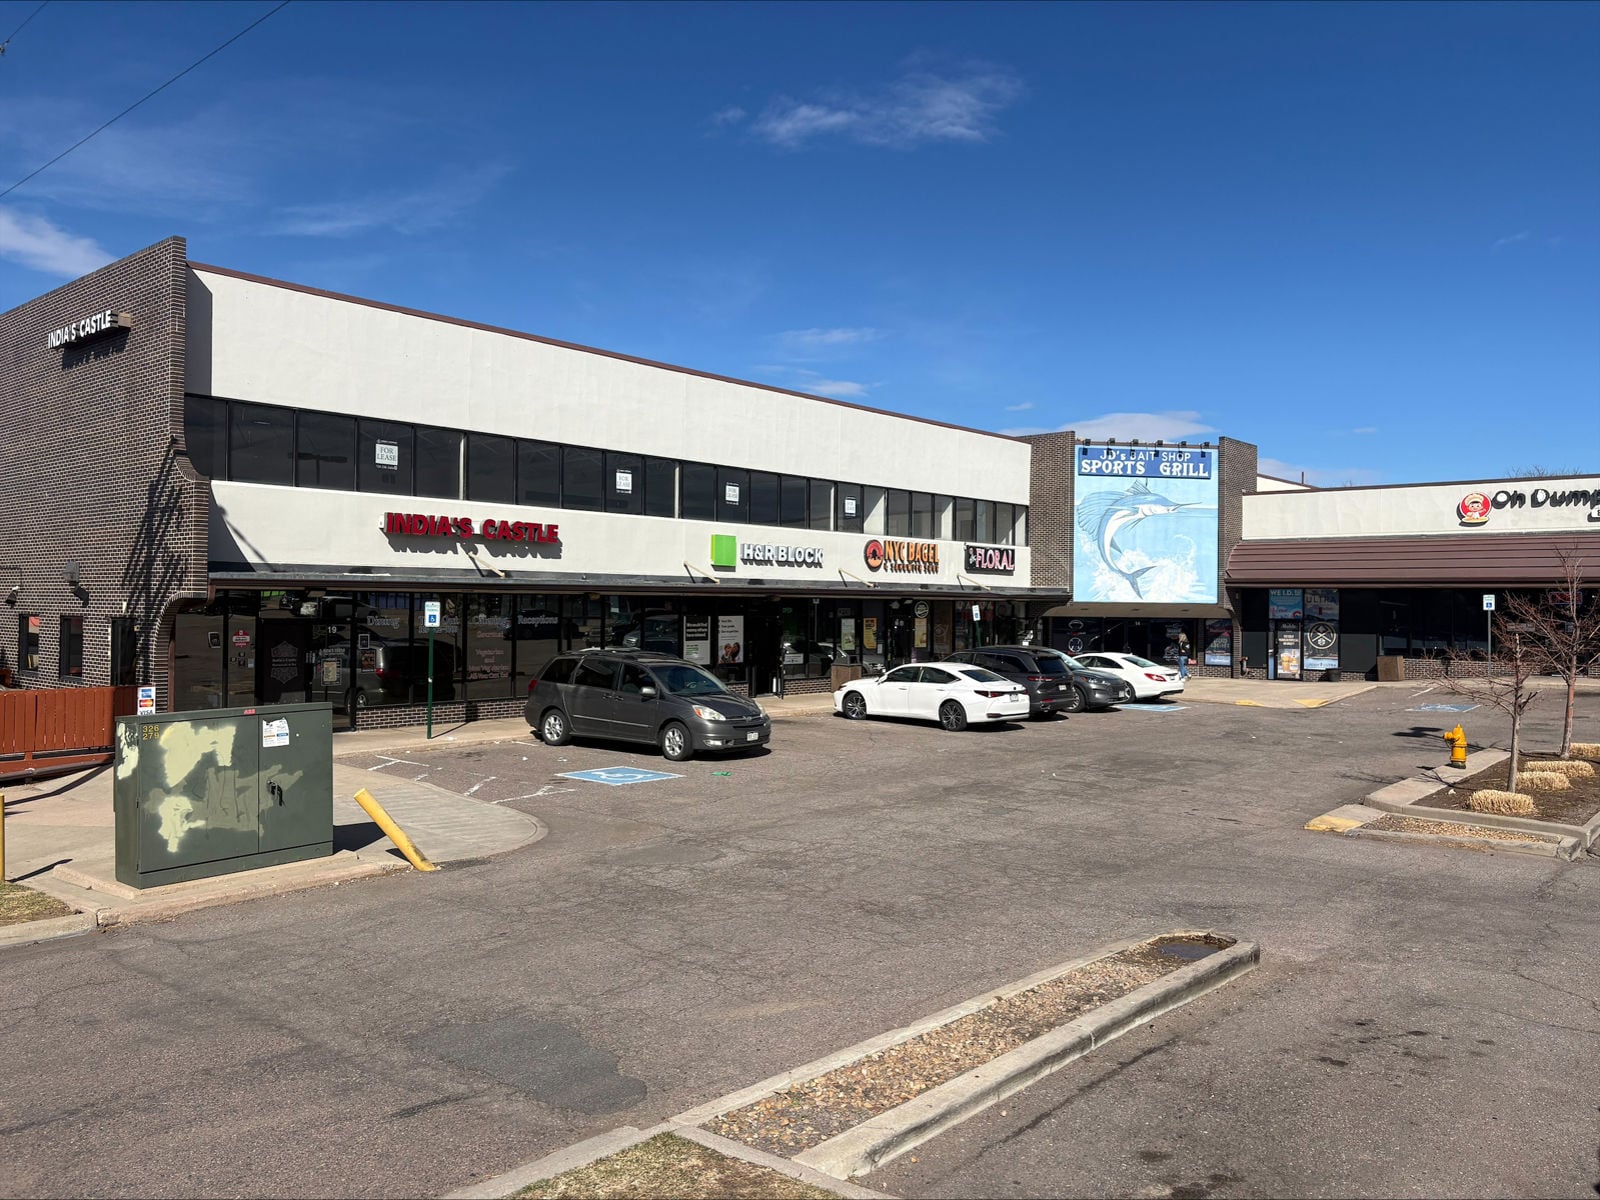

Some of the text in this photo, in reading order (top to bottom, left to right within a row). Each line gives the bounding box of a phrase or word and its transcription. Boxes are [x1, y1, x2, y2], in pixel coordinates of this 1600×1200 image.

[48, 310, 111, 348] INDIA'S CASTLE
[377, 453, 396, 461] LEASE
[1161, 452, 1191, 462] SHOP
[1081, 459, 1209, 477] SPORTS GRILL
[1491, 490, 1526, 509] On
[386, 512, 559, 543] INDIA'S CASTLE
[743, 543, 824, 564] H&R BLOCK
[884, 540, 940, 564] NYC BAGEL
[975, 547, 1015, 570] FLORAL
[517, 614, 559, 628] Receptions
[328, 626, 337, 635] 19
[142, 725, 159, 733] 326
